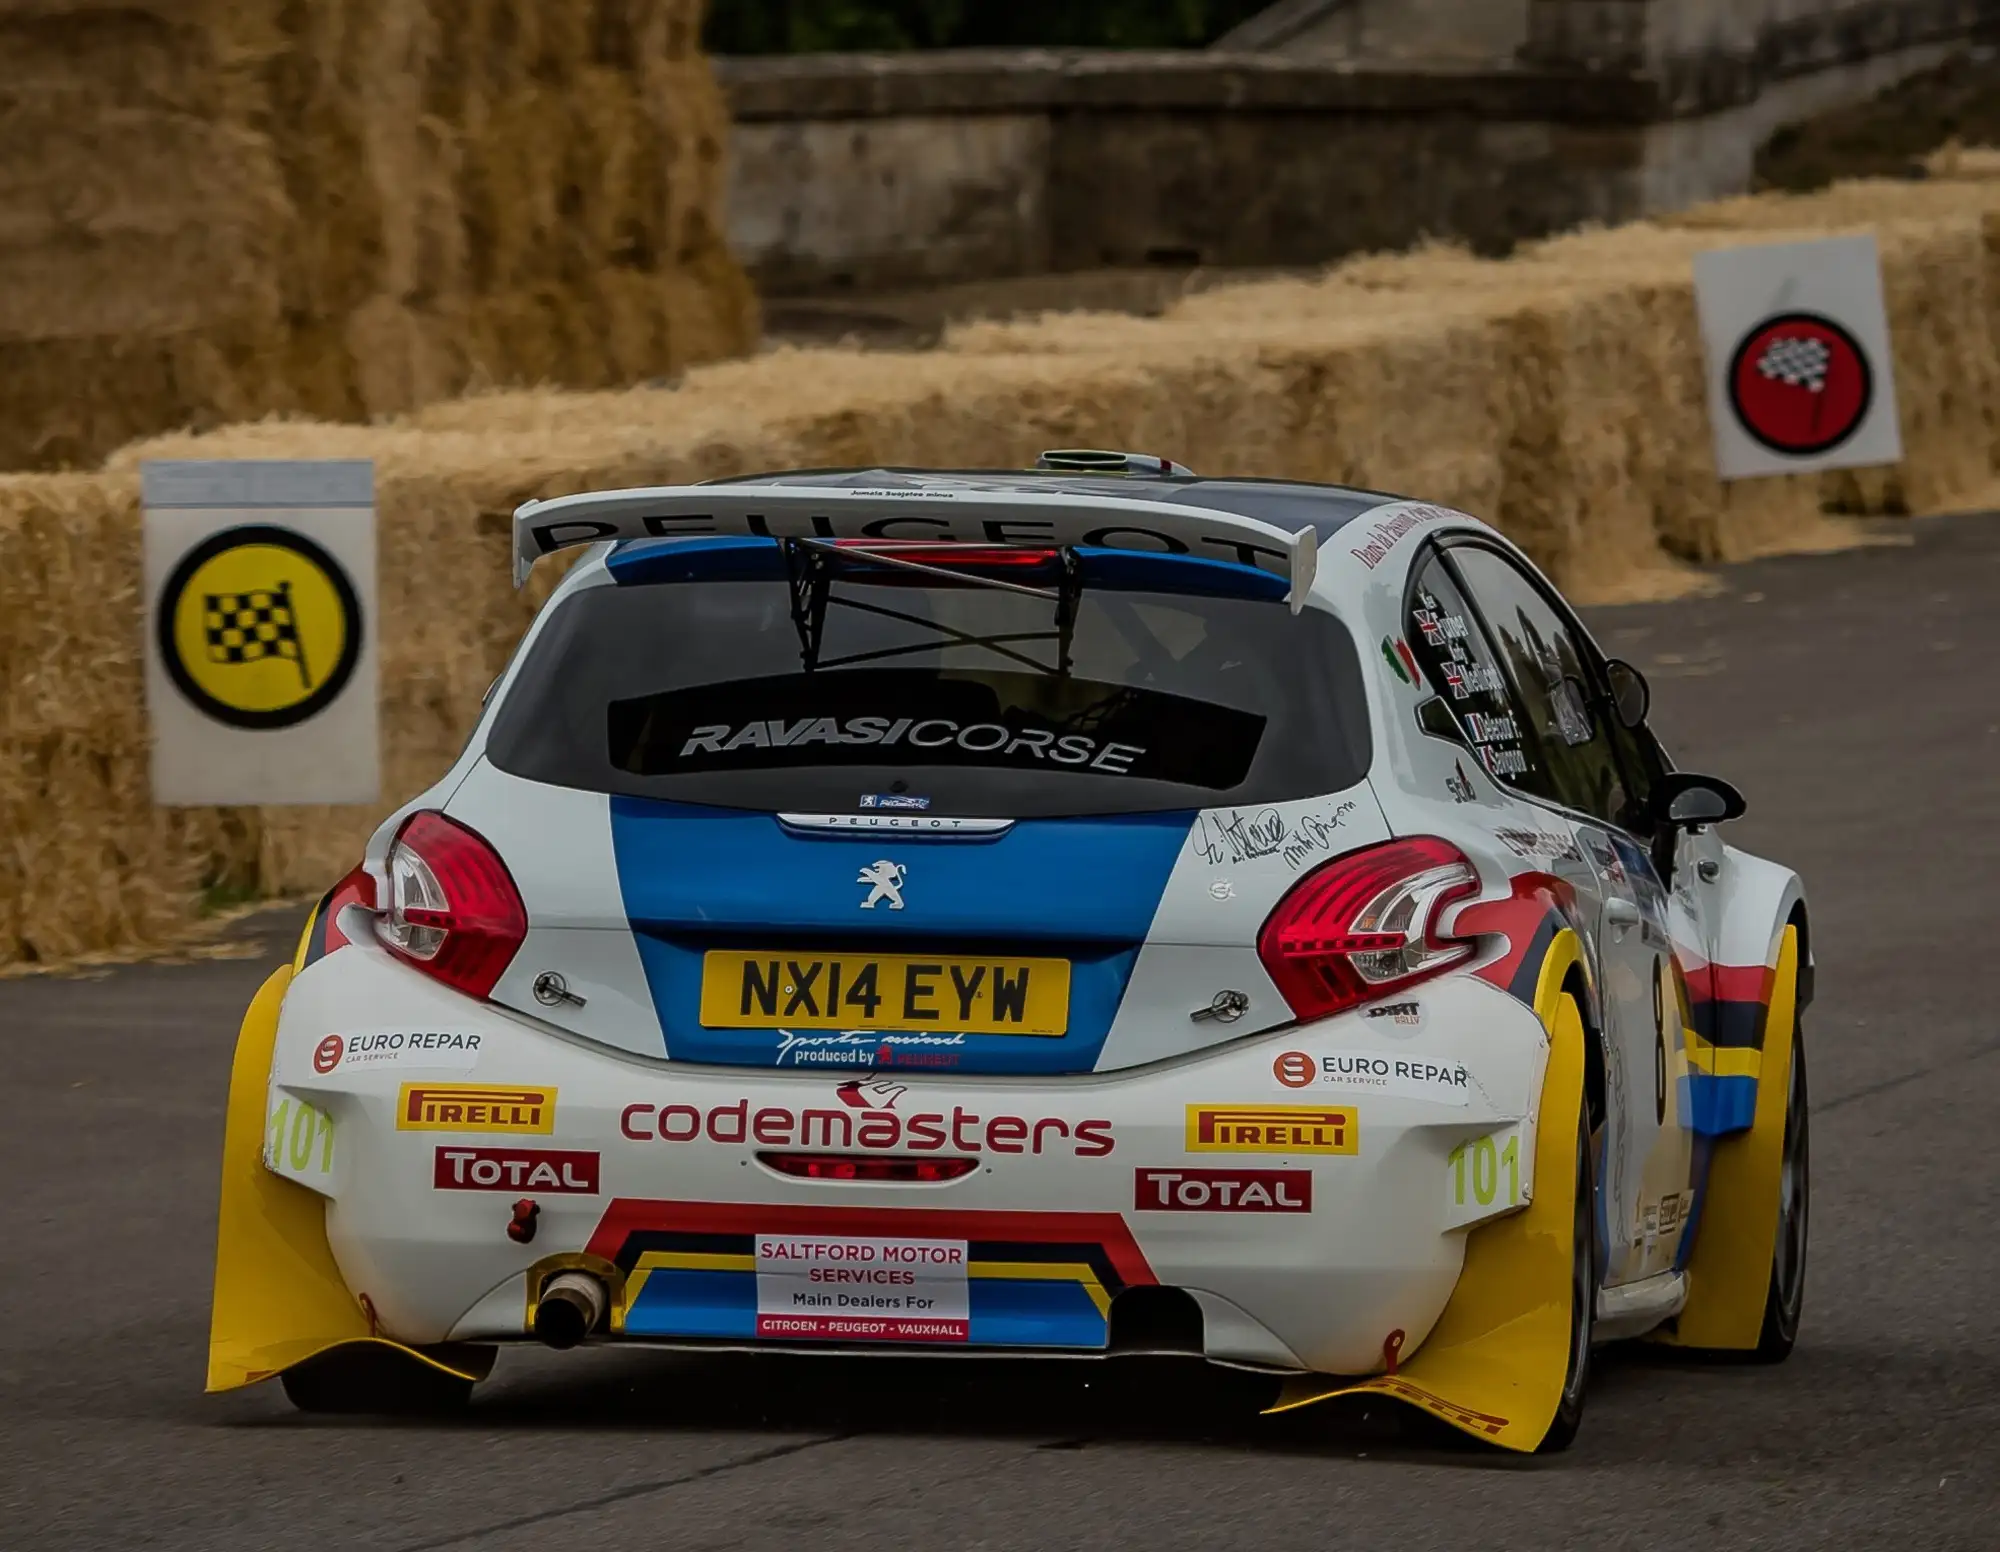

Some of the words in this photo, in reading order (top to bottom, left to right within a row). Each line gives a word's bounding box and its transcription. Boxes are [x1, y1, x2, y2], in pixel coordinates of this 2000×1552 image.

[828, 817, 962, 829] PEUGEOT
[740, 960, 882, 1019] NX14
[903, 964, 1029, 1023] EYW
[348, 1033, 403, 1053] EURO
[407, 1033, 482, 1051] REPAR
[346, 1054, 362, 1063] CAR
[363, 1052, 399, 1062] SERVICE
[795, 1049, 856, 1065] produced
[858, 1050, 875, 1066] by
[1322, 1056, 1390, 1076] EURO
[1394, 1061, 1468, 1088] REPAR
[1323, 1075, 1343, 1083] CAR
[1346, 1076, 1388, 1086] SERVICE
[407, 1089, 546, 1125] PIRELLI
[270, 1099, 335, 1173] 101
[620, 1098, 1117, 1157] codemasters
[1198, 1111, 1346, 1147] PIRELLI
[444, 1152, 589, 1188] TOTAL
[1447, 1135, 1519, 1206] 101
[1147, 1173, 1303, 1207] TOTAL
[760, 1242, 876, 1262] SALTFORD
[881, 1246, 963, 1265] MOTOR
[809, 1268, 916, 1286] SERVICES
[792, 1293, 831, 1307] Main
[837, 1294, 900, 1309] Dealers
[905, 1297, 934, 1310] For
[762, 1319, 818, 1332] CITROEN
[828, 1321, 886, 1334] PEUGEOT
[898, 1324, 964, 1337] VAUXHALL
